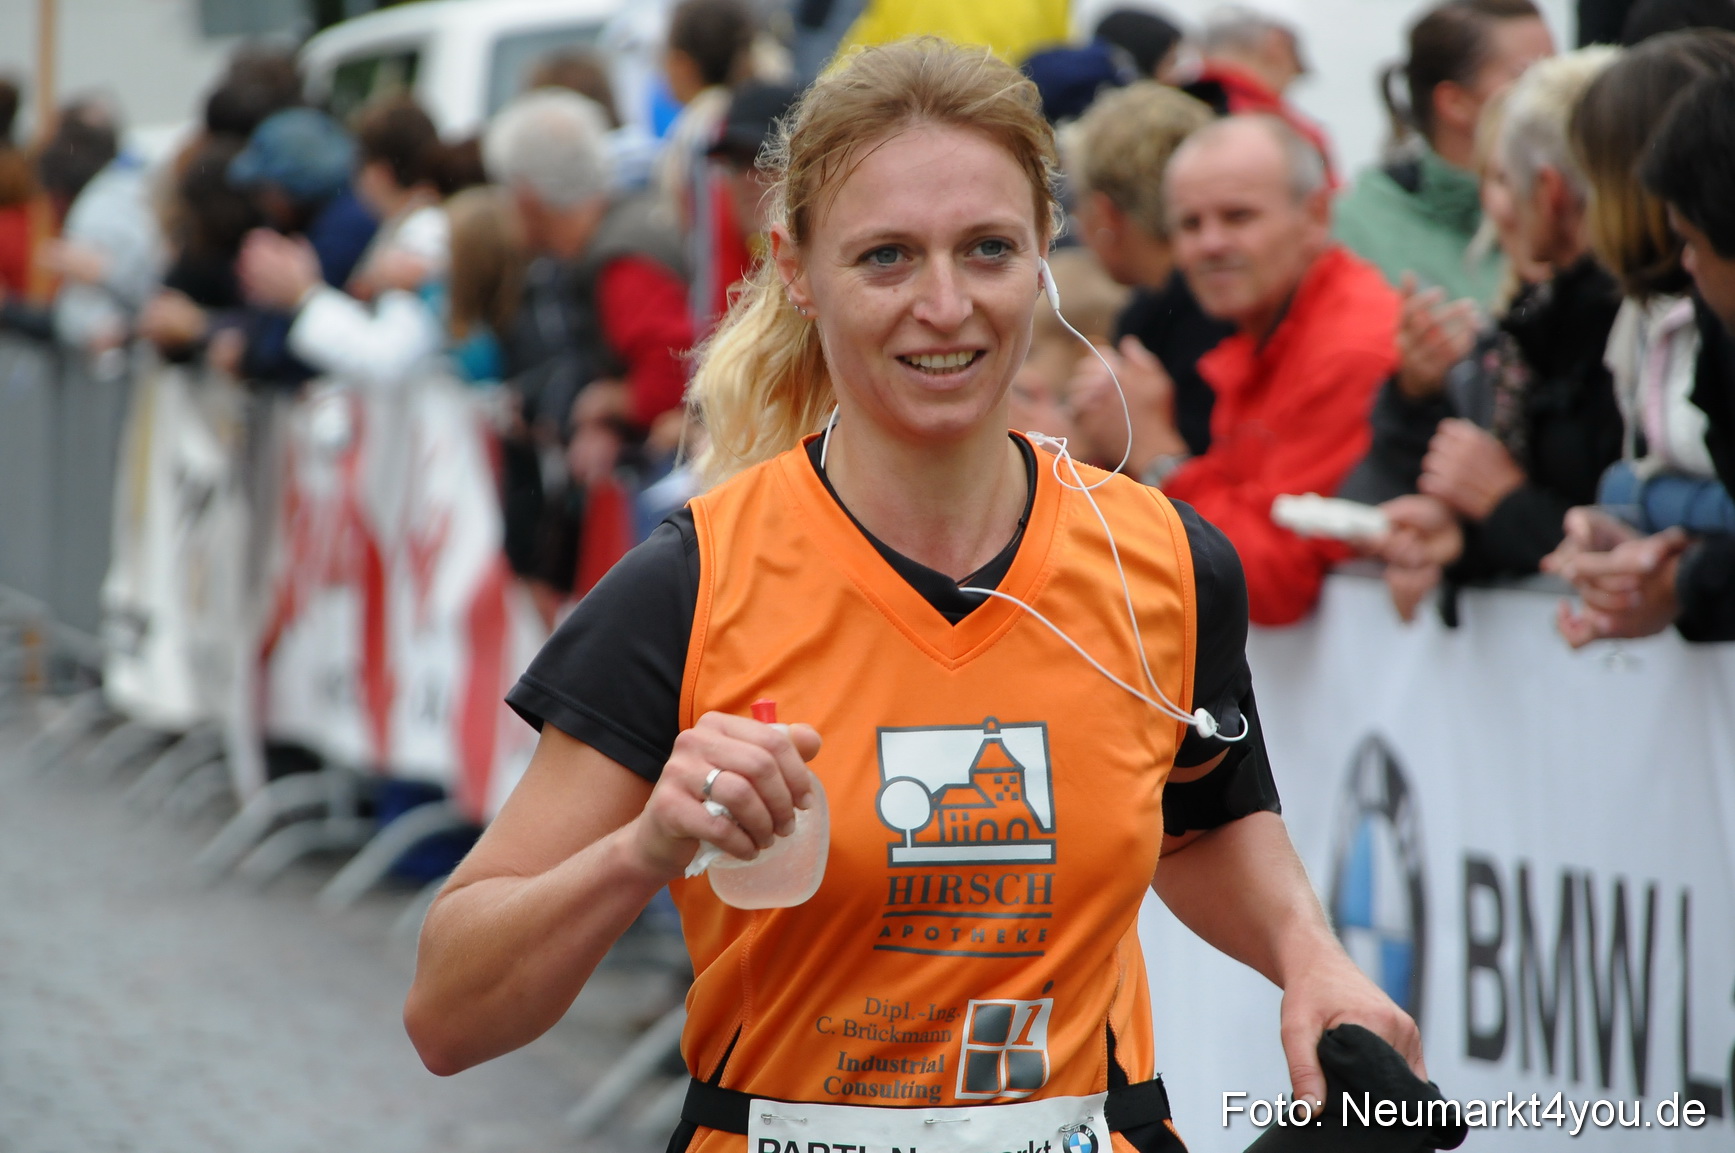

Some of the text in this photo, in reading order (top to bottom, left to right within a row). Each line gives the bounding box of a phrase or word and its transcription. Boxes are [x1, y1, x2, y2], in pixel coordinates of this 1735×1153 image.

[885, 873, 1055, 906] HIRSCH
[879, 925, 1047, 944] APOTHEKE
[1462, 850, 1735, 1119] BMW L
[864, 997, 961, 1023] Dipl.-Ing.
[816, 1016, 952, 1044] C. Brückmann
[837, 1051, 945, 1075] Industrial
[824, 1075, 942, 1104] Consulting
